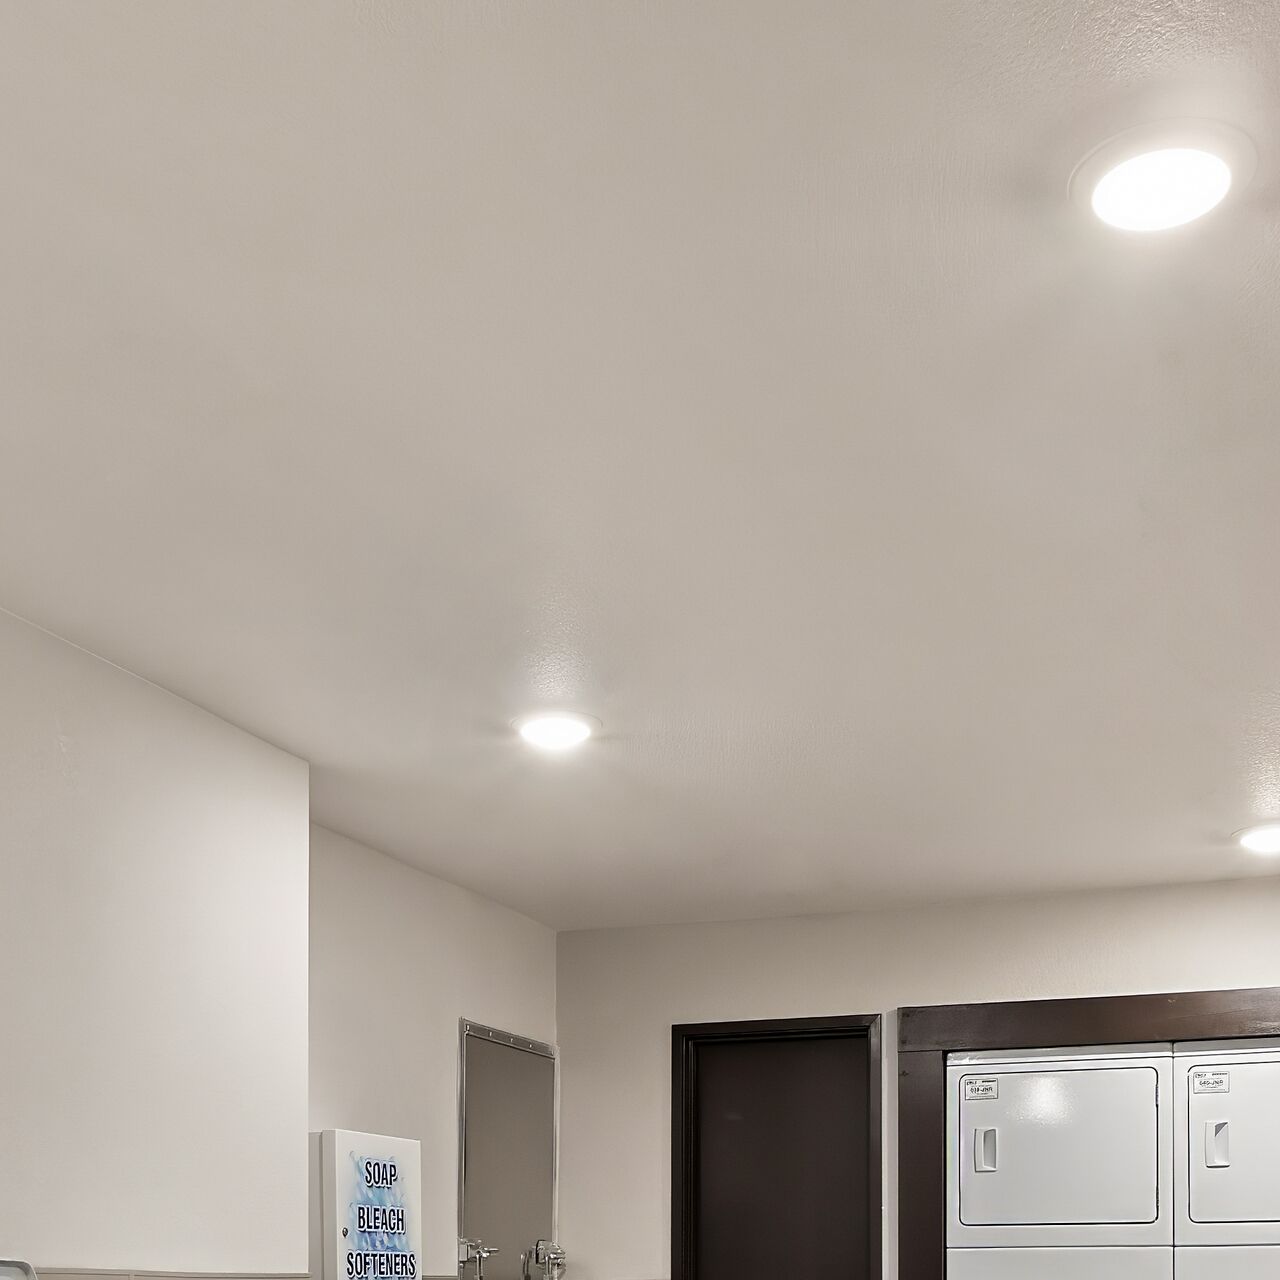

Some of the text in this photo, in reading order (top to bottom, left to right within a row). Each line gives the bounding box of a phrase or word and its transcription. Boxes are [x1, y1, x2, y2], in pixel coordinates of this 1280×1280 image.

[365, 1161, 397, 1187] SOAP
[357, 1206, 405, 1232] BLEACH
[346, 1252, 416, 1277] SOFTENERS
